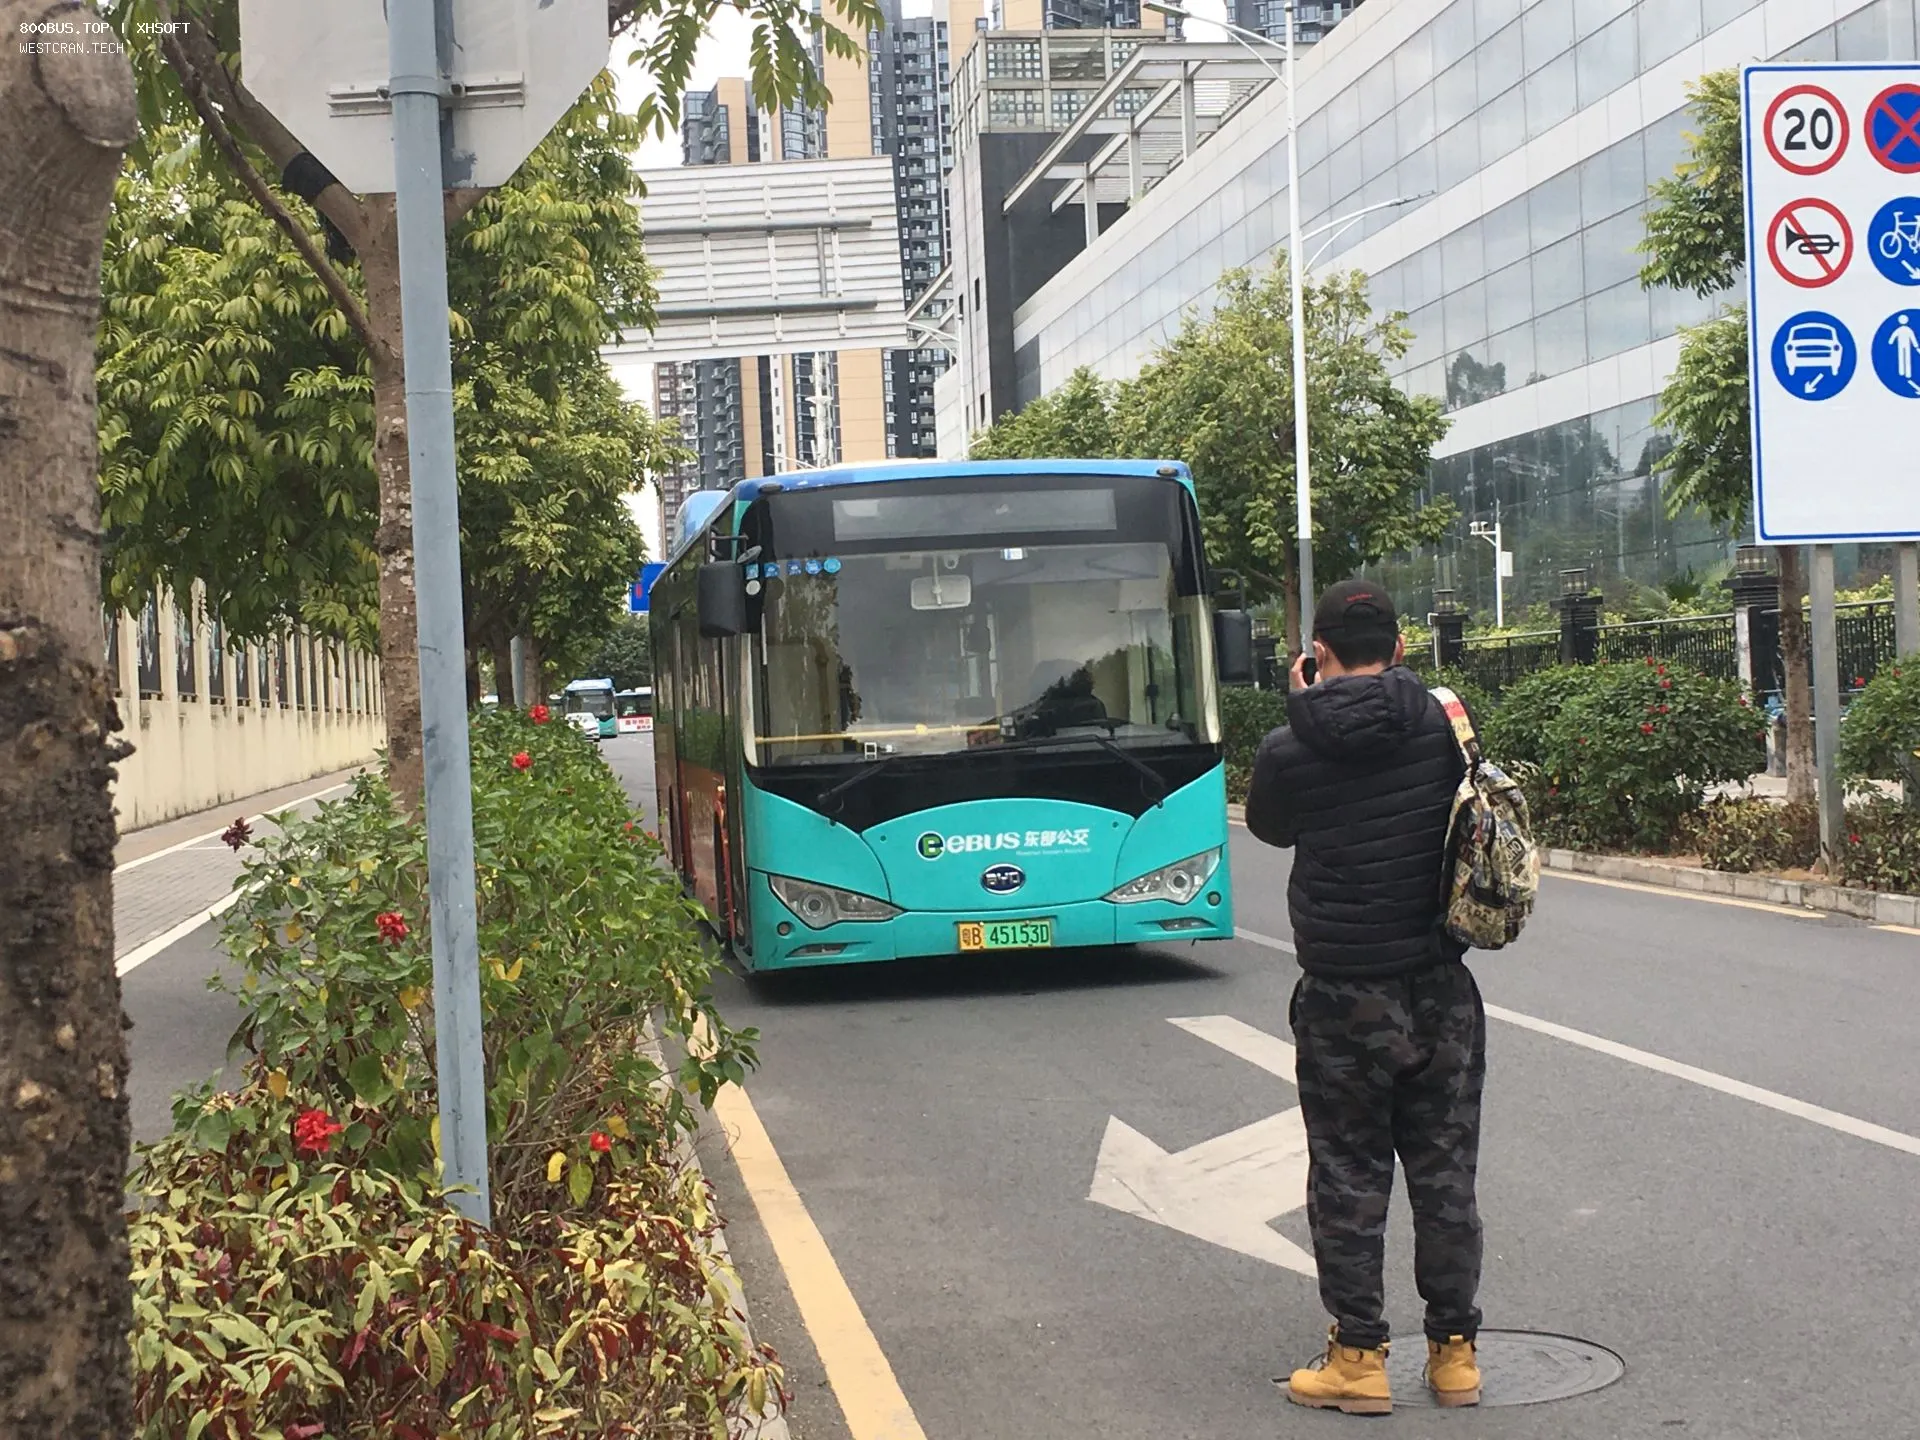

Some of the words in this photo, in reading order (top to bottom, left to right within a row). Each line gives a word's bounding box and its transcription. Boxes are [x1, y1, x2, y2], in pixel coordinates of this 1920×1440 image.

[1783, 107, 1834, 151] 20
[1023, 828, 1090, 848] 东部公交
[985, 871, 1021, 885] BYD
[989, 924, 1050, 945] 45153D
